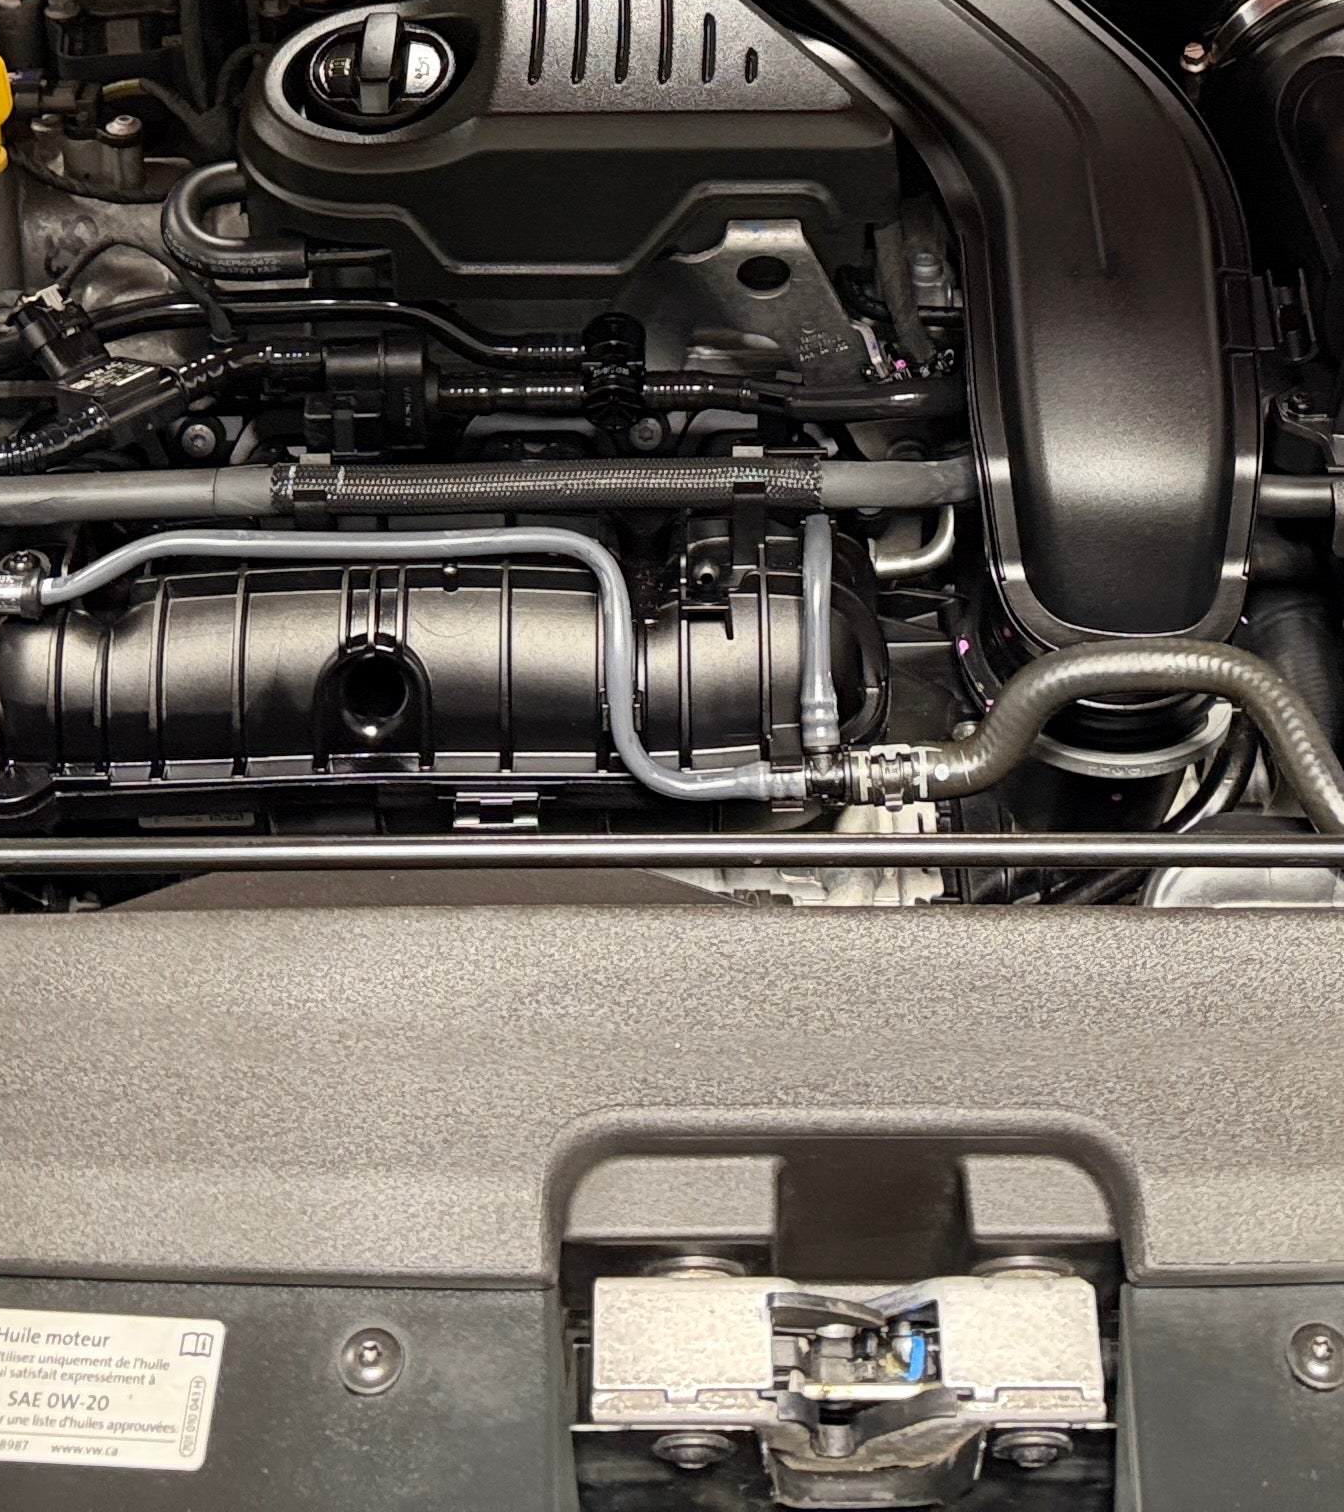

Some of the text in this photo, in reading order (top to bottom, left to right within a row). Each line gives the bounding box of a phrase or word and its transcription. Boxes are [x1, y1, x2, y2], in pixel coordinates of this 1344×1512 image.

[45, 1333, 110, 1348] moteur
[38, 1353, 112, 1369] uniquement
[115, 1356, 131, 1369] de
[133, 1357, 171, 1372] l'huile
[9, 1367, 58, 1380] satisfait
[60, 1369, 141, 1386] expressément
[147, 1373, 157, 1386] à
[7, 1390, 43, 1408] SAE
[47, 1392, 111, 1412] 0W-20
[7, 1415, 30, 1426] une
[32, 1413, 57, 1427] liste
[59, 1414, 105, 1430] d'huiles
[51, 1443, 119, 1457] www.vw.ca
